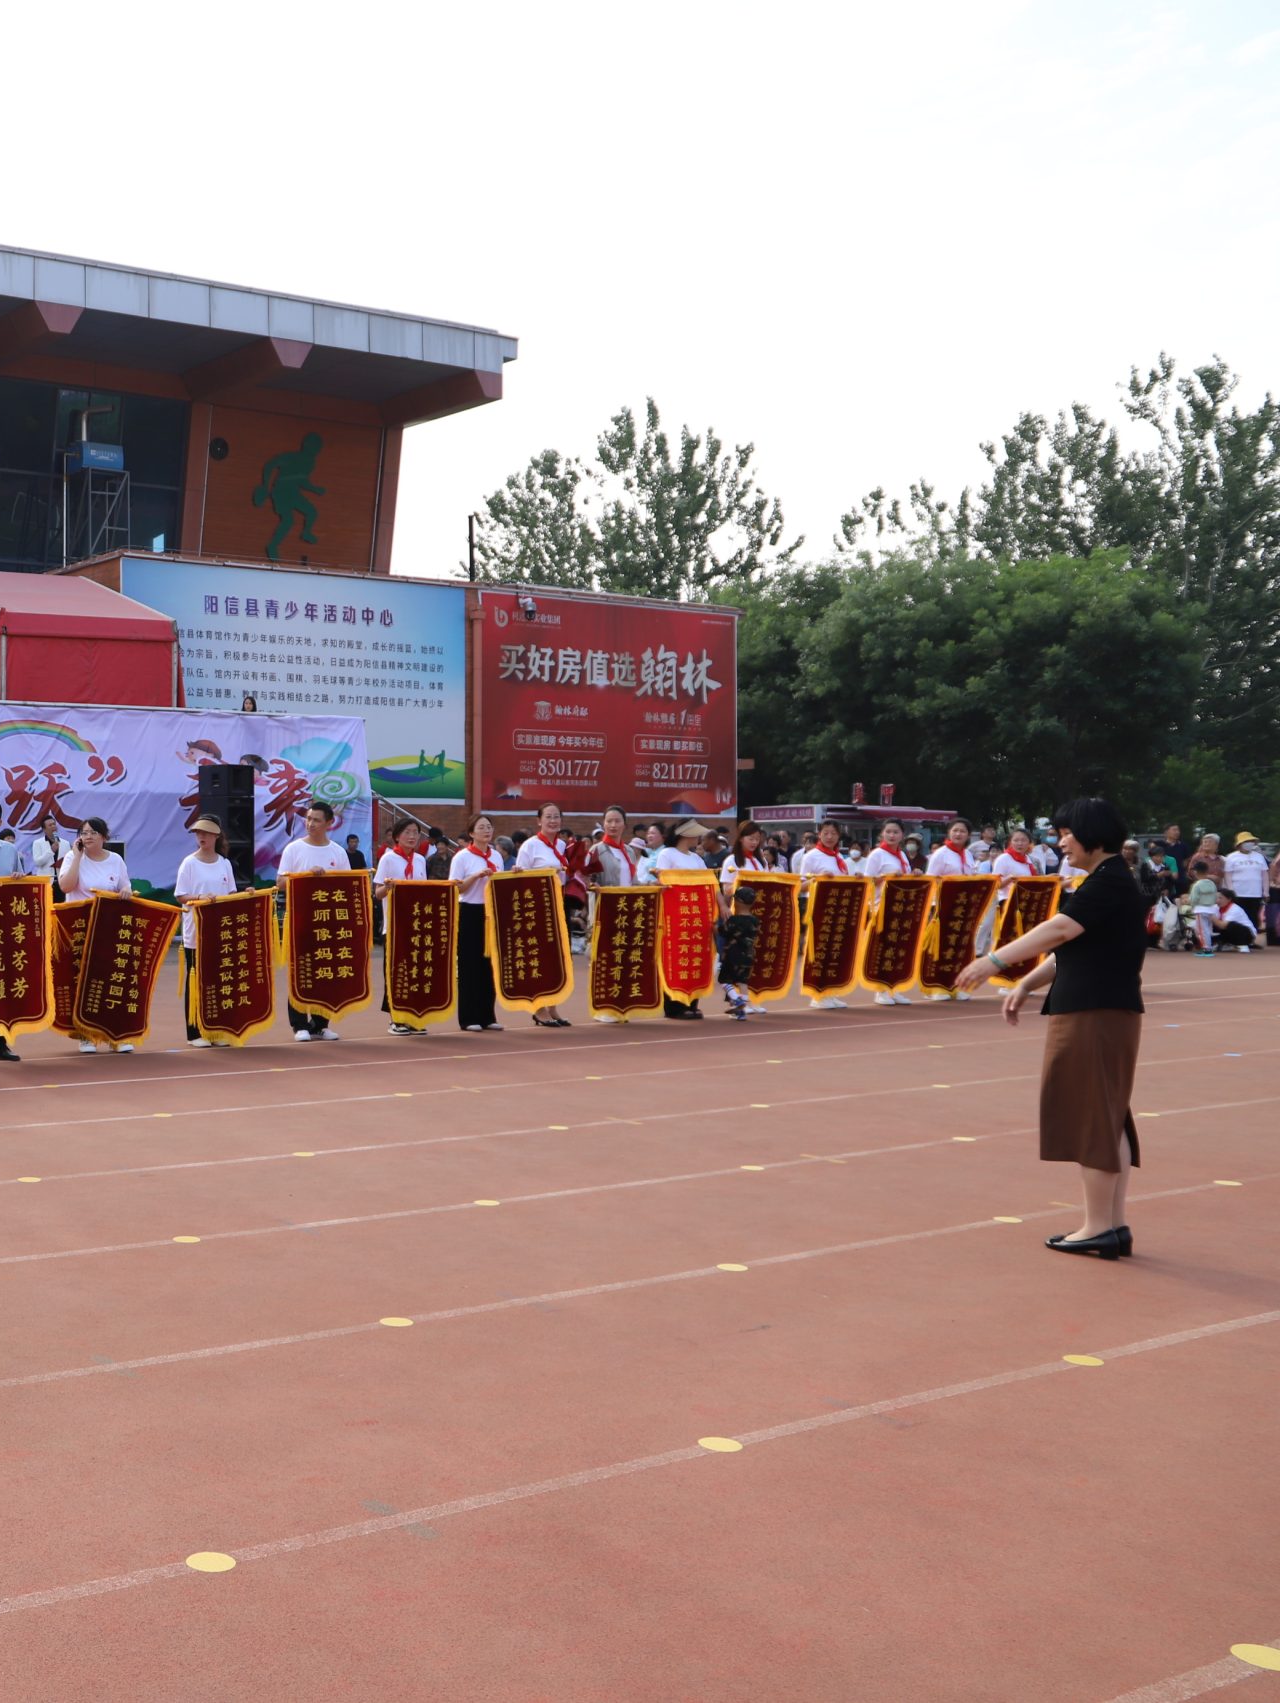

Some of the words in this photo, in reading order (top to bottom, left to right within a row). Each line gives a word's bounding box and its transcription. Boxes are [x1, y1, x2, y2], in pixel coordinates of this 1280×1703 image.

[204, 594, 395, 627] 阳信县青少年活动中心
[498, 643, 723, 705] 买好房值选翰林
[538, 758, 601, 777] 8501777
[652, 762, 709, 781] 8211777
[9, 895, 31, 999] 桃李芬芳
[104, 914, 133, 1011] 倾情倾智好园丁
[219, 915, 235, 1010] 无微不至似母情
[311, 889, 334, 980] 老师像妈妈
[331, 889, 355, 979] 在园如在家
[608, 895, 630, 999] 关怀教育有方
[628, 894, 647, 999] 疼爱无微不至
[677, 891, 691, 981] 无微不至育幼苗
